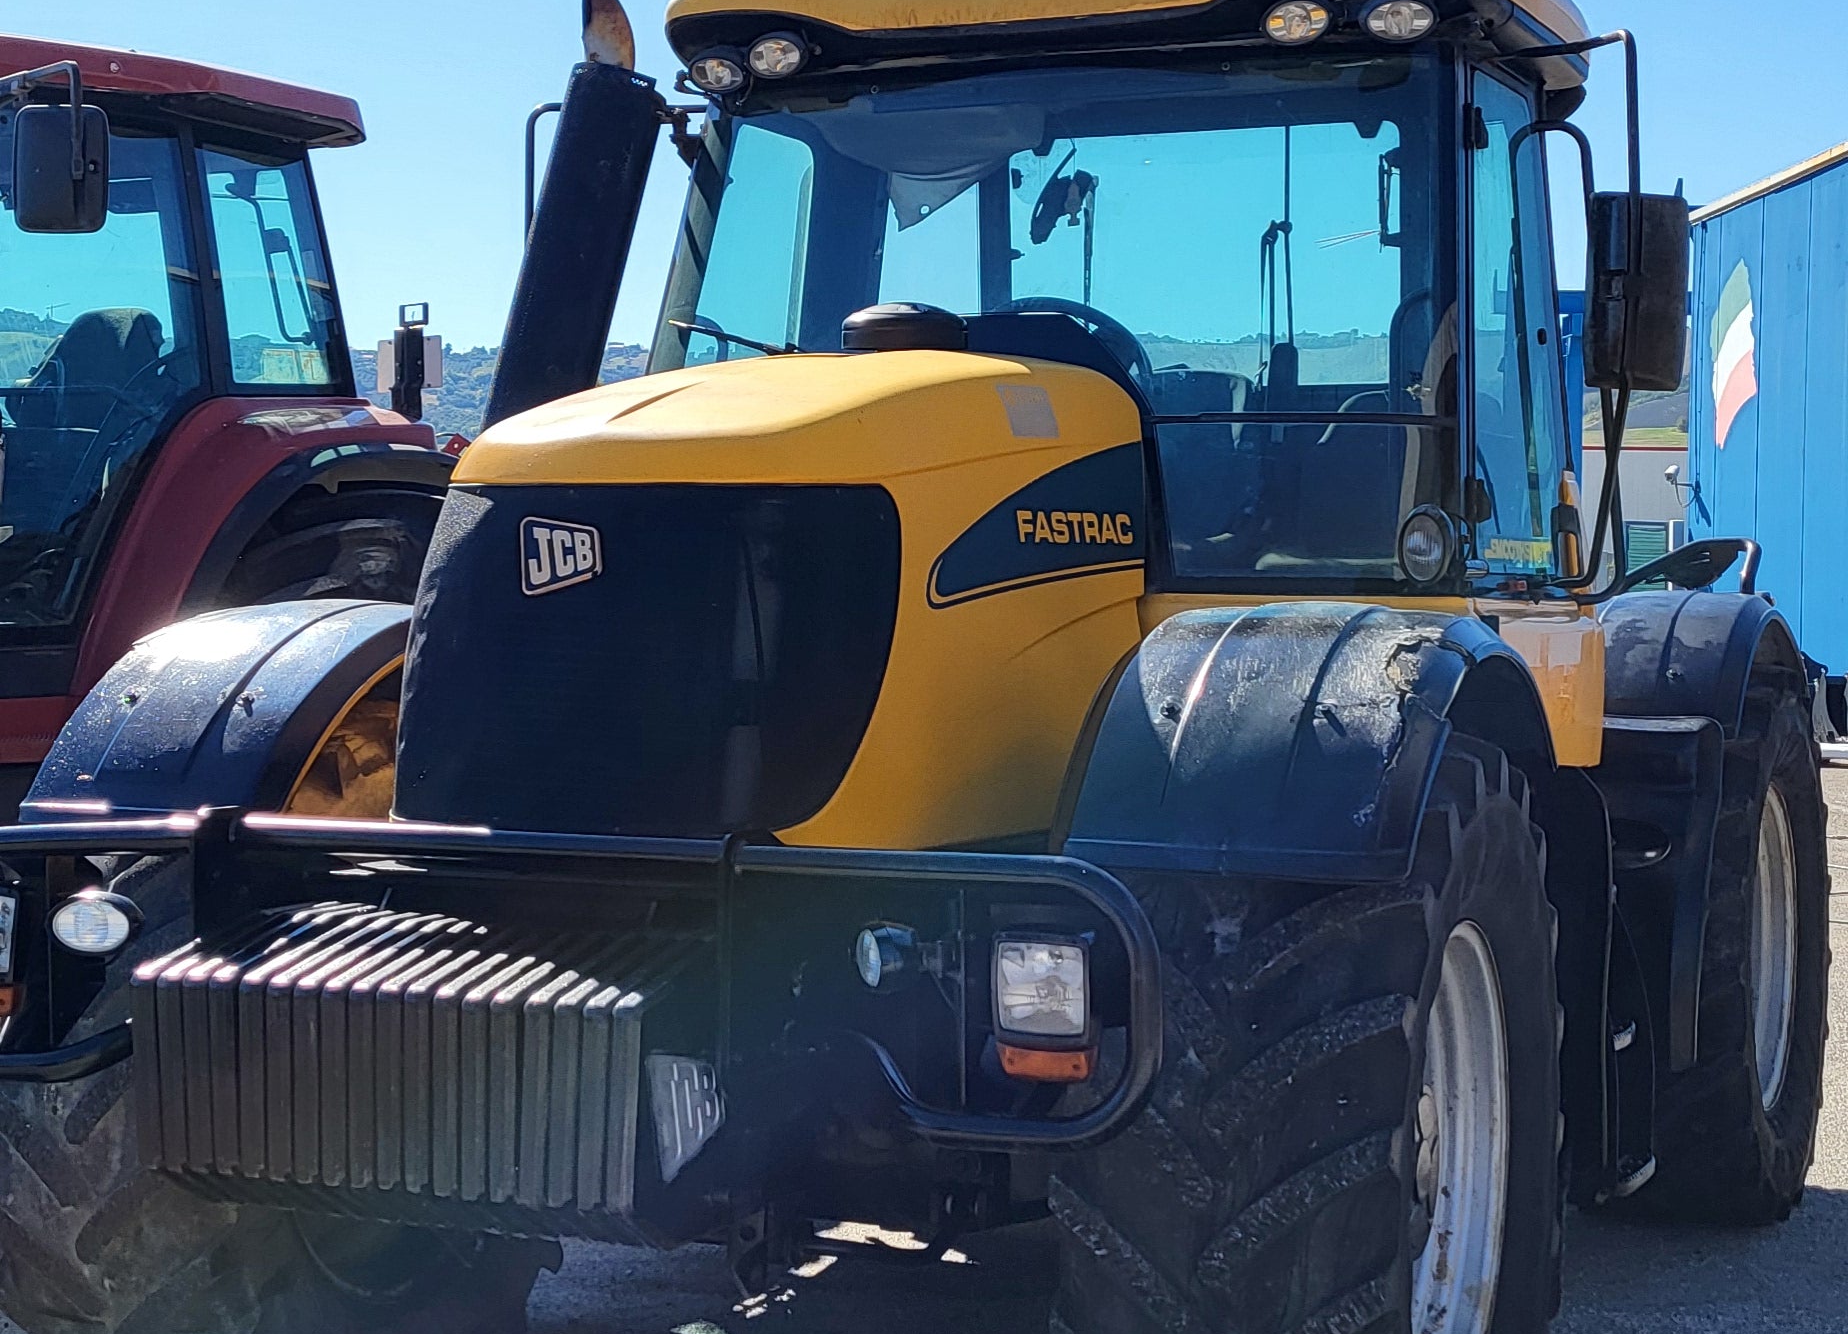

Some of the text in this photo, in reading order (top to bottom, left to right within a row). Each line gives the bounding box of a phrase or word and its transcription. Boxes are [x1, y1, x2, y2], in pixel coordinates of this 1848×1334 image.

[528, 526, 593, 585] JCB
[1016, 510, 1134, 544] FASTRAC
[659, 1060, 720, 1165] JCB
